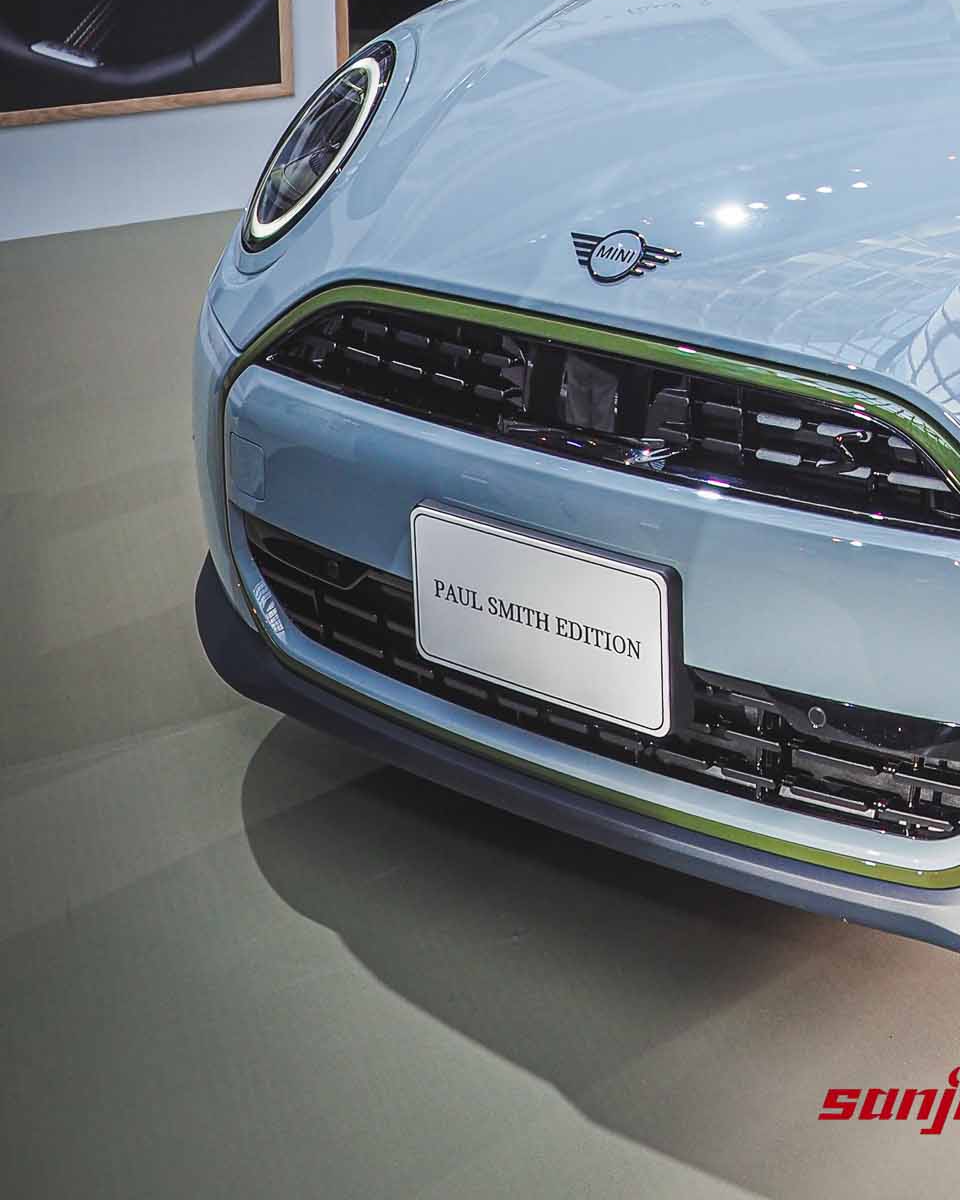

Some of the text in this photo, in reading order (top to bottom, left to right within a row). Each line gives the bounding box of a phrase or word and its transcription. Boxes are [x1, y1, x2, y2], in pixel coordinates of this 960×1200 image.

[596, 245, 635, 264] MINI
[434, 579, 641, 659] PAUL SMITH EDITION
